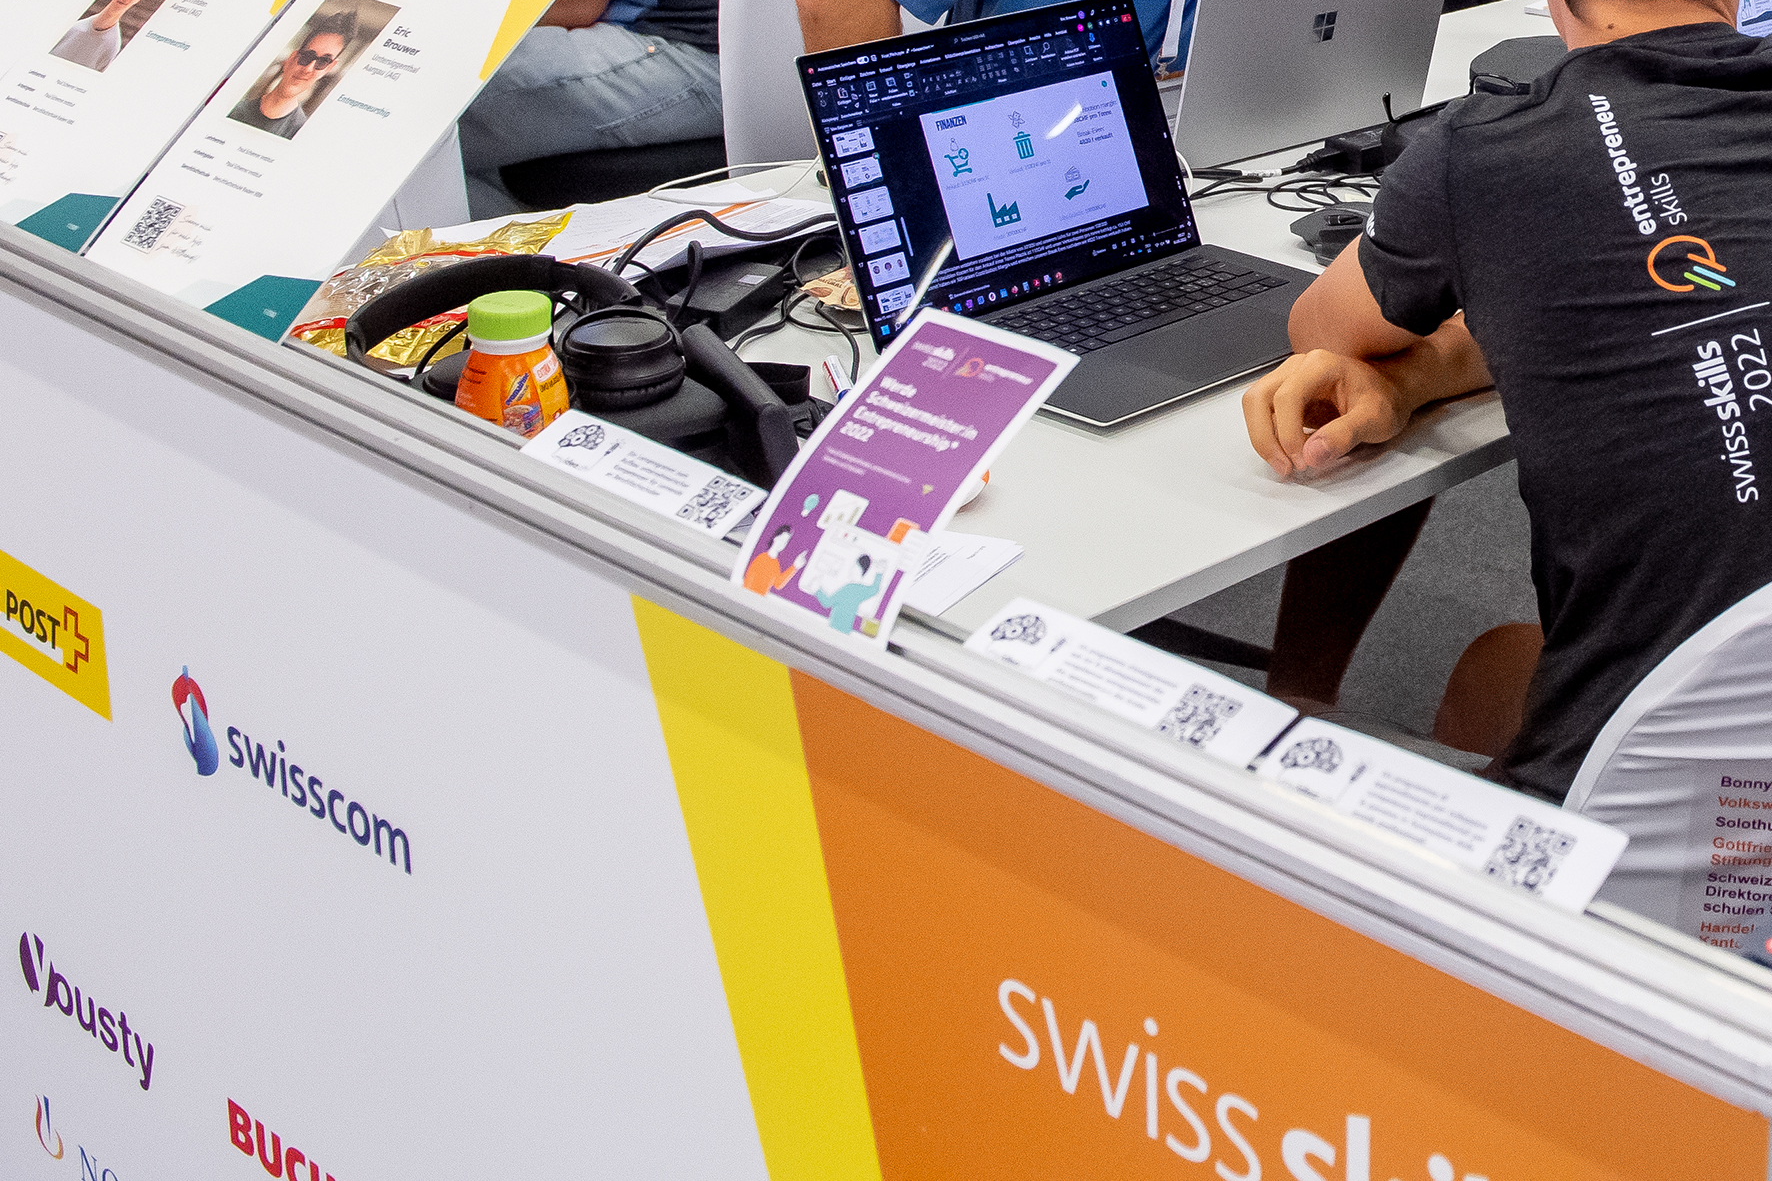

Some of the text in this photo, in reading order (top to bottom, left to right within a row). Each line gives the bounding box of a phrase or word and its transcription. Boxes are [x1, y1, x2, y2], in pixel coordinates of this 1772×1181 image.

[393, 25, 411, 38] Eric
[383, 38, 421, 57] Brouwer
[337, 94, 391, 119] Entrepreneurship
[935, 115, 968, 131] FINANZEN
[1588, 93, 1657, 236] entrepreneur
[1649, 172, 1688, 226] skills
[1691, 340, 1759, 503] swissskills
[4, 587, 60, 651] POST
[1720, 776, 1772, 793] Bonny
[227, 725, 413, 876] swisscom
[1703, 902, 1765, 916] schulen
